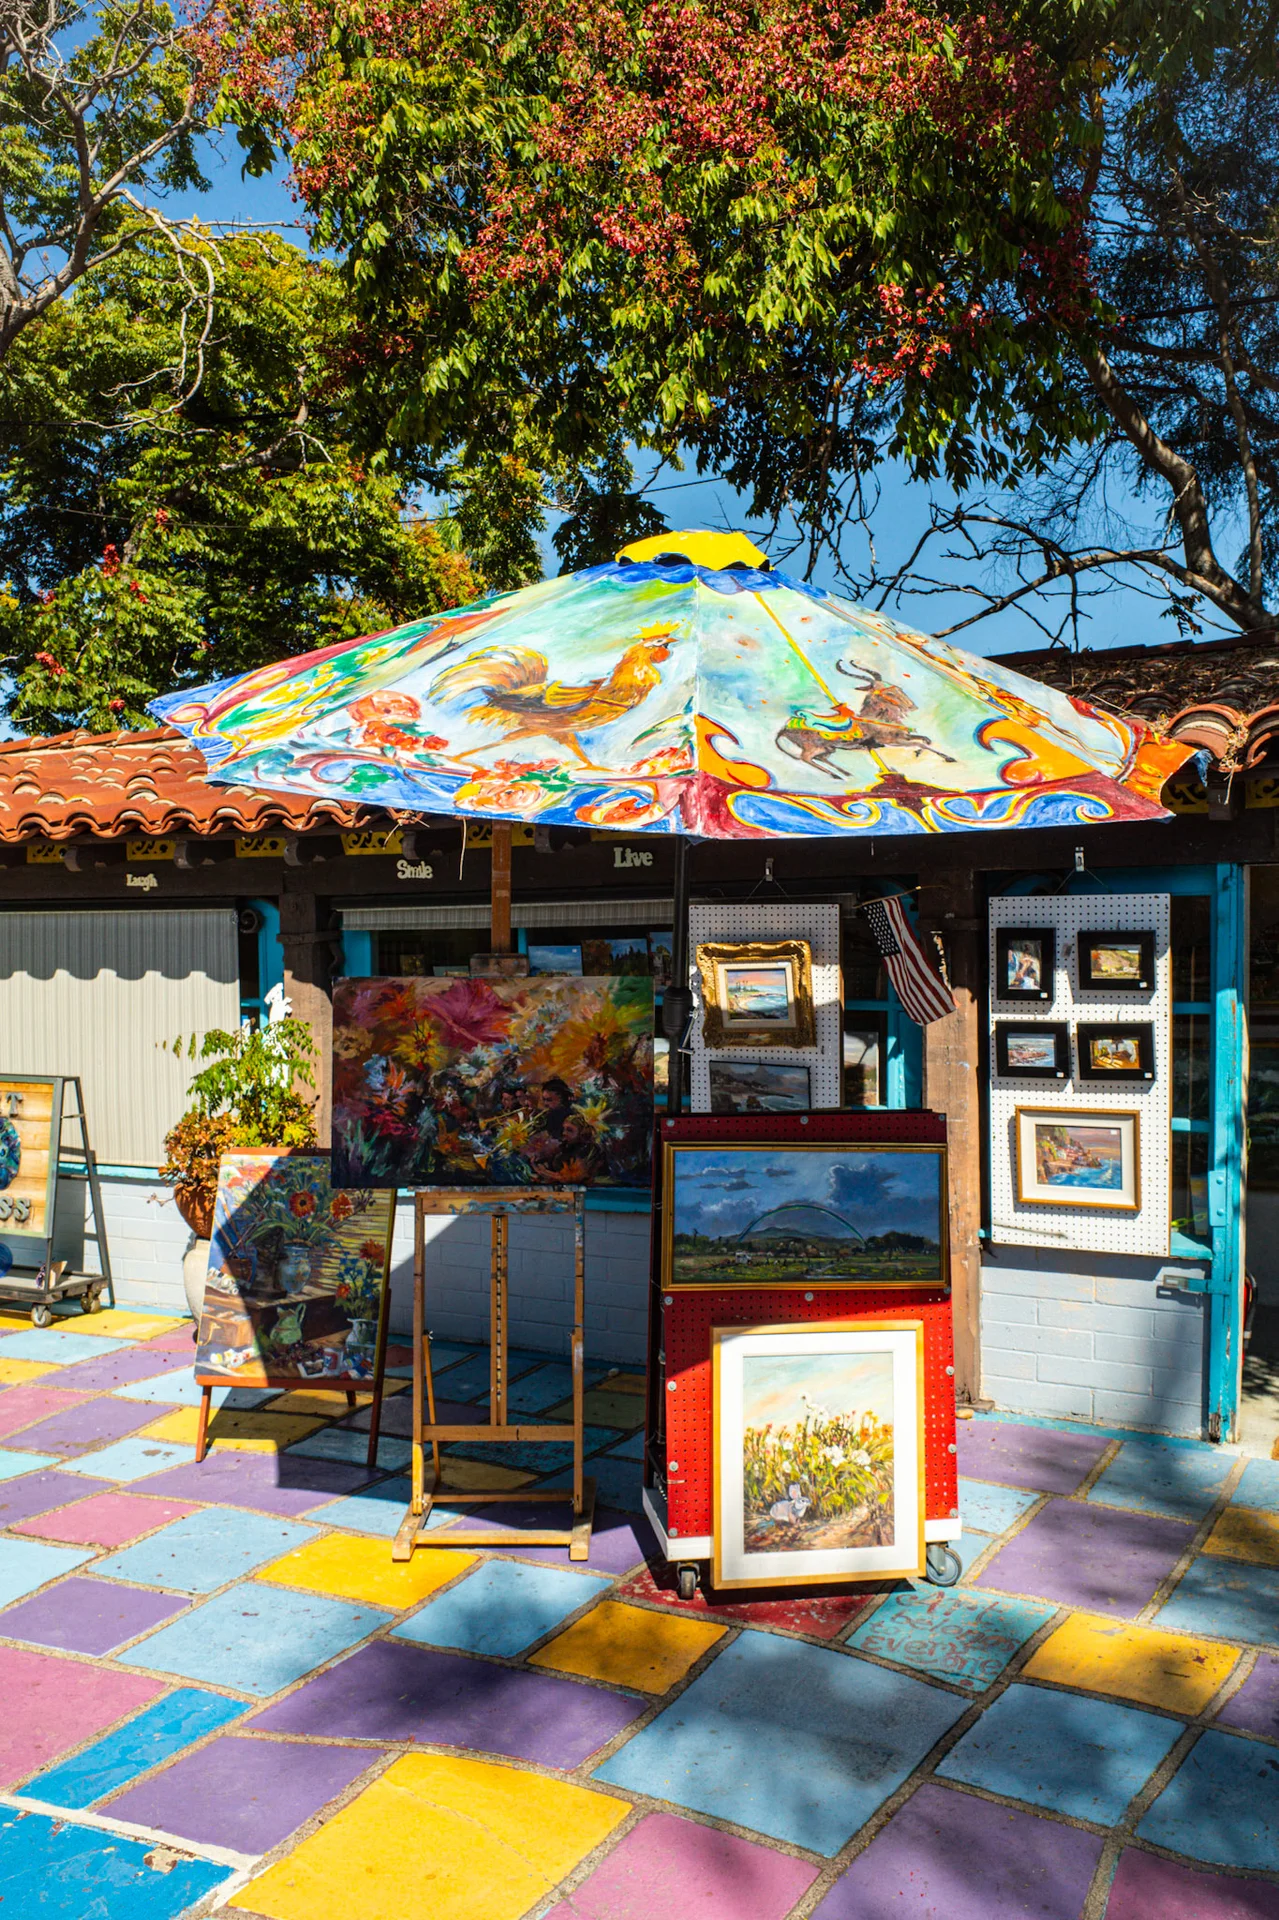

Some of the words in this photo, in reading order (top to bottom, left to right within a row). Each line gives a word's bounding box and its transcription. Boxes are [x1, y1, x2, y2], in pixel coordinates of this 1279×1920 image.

[613, 847, 653, 868] Live
[397, 860, 433, 879] Smile
[126, 873, 158, 891] Laugh
